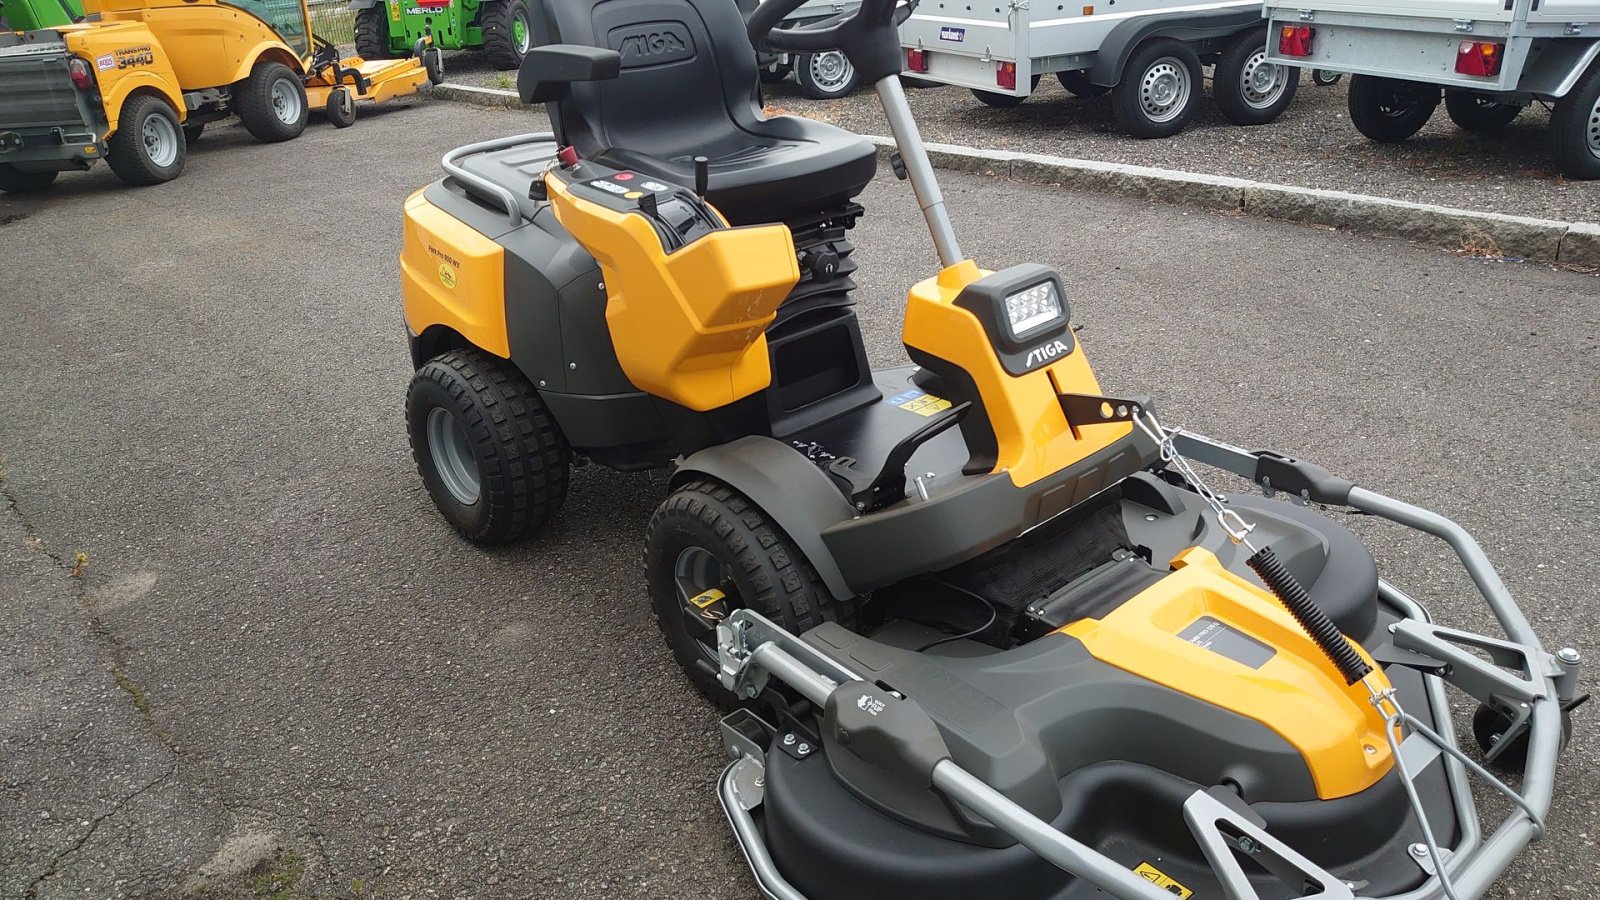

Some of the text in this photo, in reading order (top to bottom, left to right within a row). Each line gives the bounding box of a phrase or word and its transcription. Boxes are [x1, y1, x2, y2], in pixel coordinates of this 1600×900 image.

[406, 7, 443, 15] MERLO
[618, 31, 685, 59] STIGA
[117, 52, 154, 70] 3440
[1026, 340, 1068, 368] STIGA
[870, 703, 883, 712] FLIP
